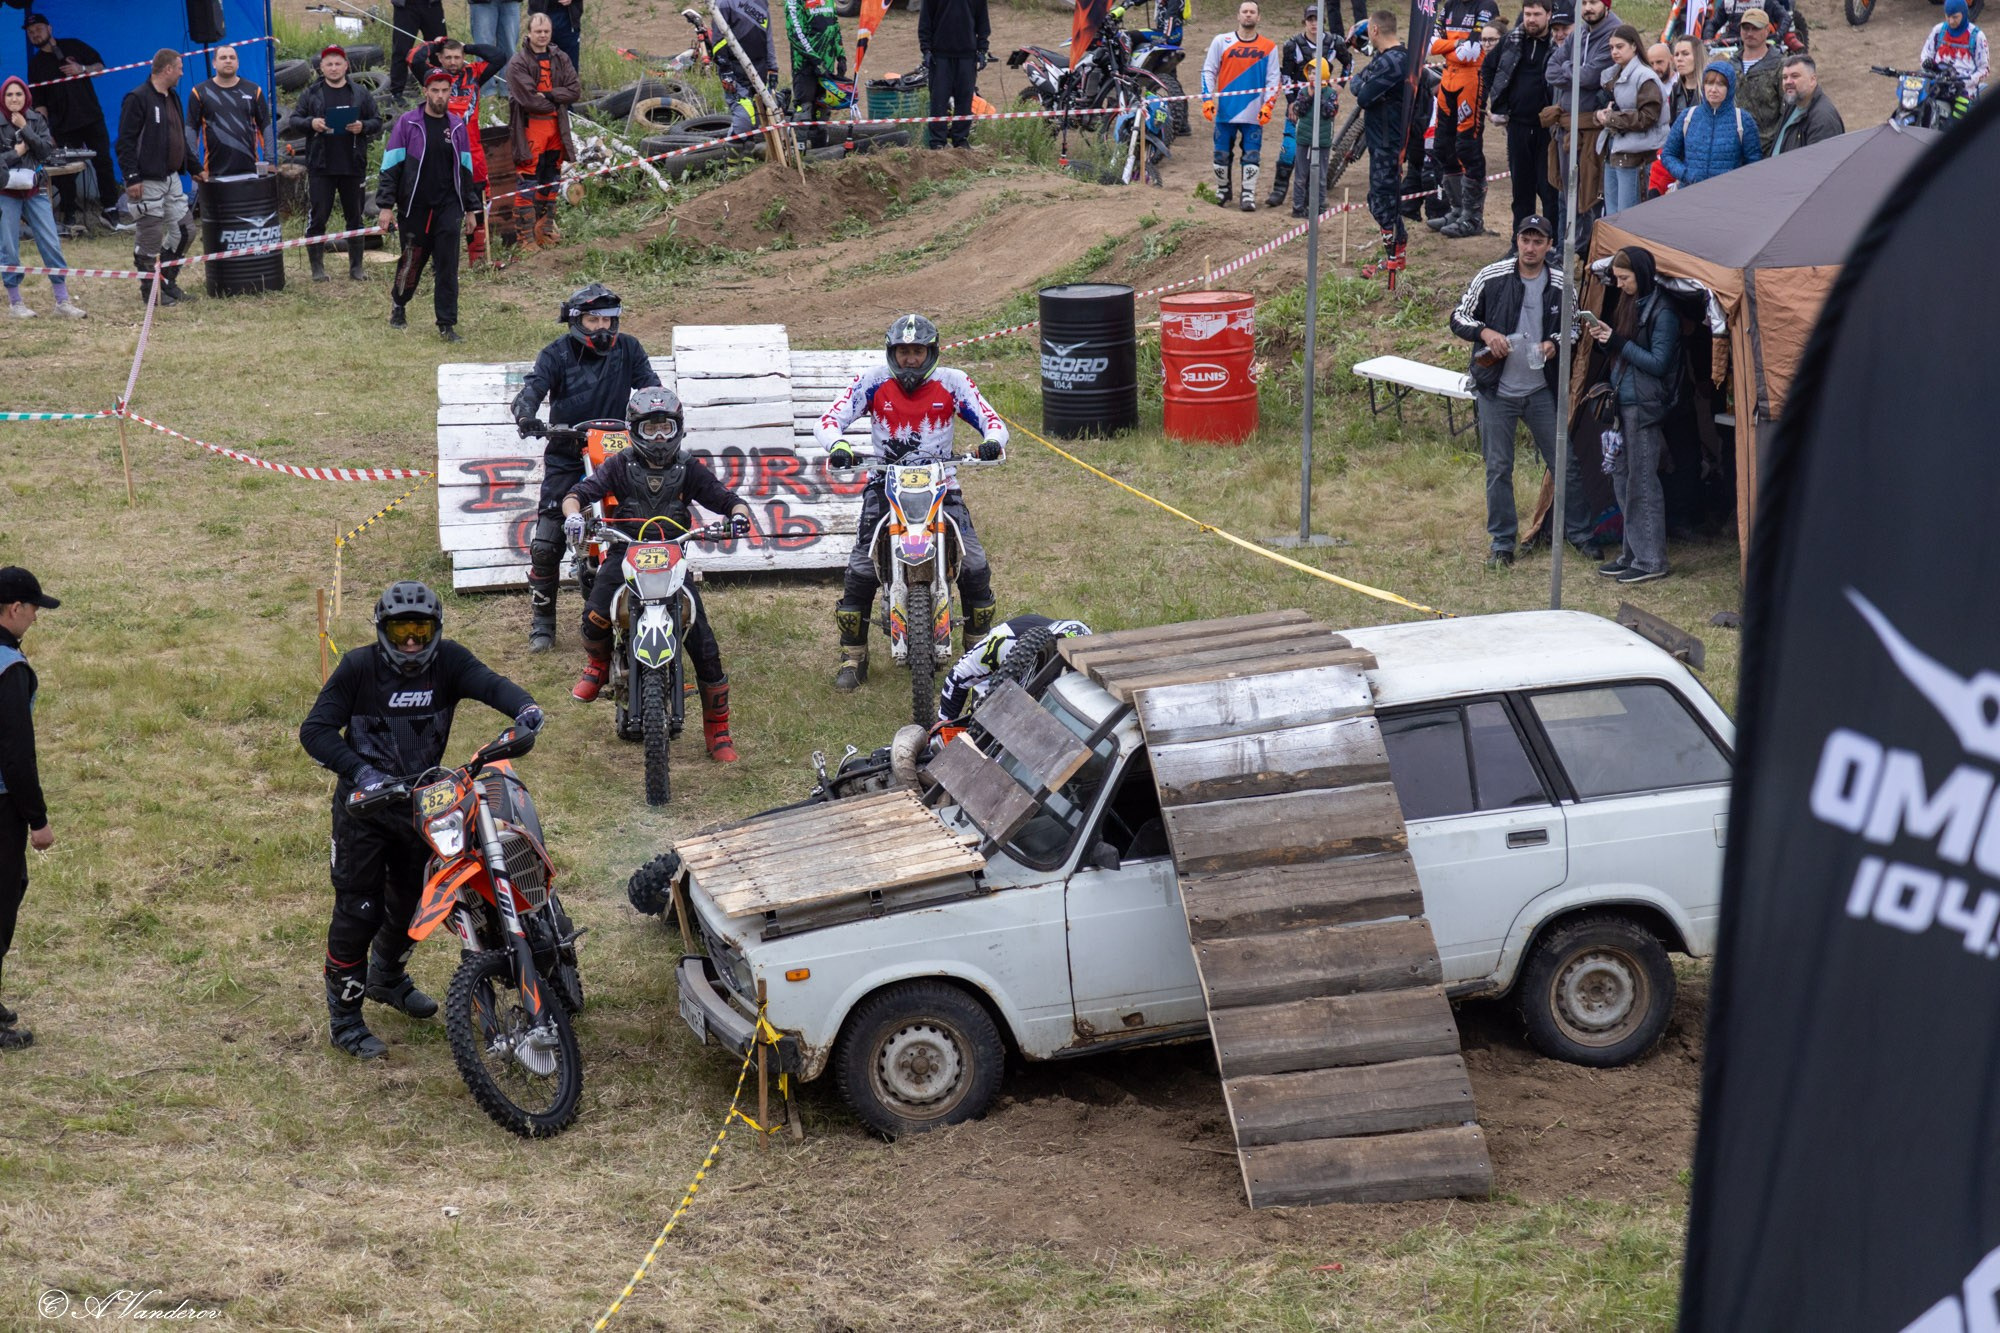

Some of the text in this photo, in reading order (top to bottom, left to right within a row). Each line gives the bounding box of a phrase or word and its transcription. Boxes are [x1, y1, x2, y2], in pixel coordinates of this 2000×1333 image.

[1228, 46, 1265, 59] KTM
[1041, 353, 1109, 373] ECORD
[1062, 373, 1097, 382] RADIO
[1181, 371, 1226, 382] SINTEC
[1053, 381, 1073, 389] 104.4
[610, 440, 624, 449] 28
[911, 475, 918, 483] 3
[644, 555, 658, 564] 21
[429, 793, 444, 808] 82
